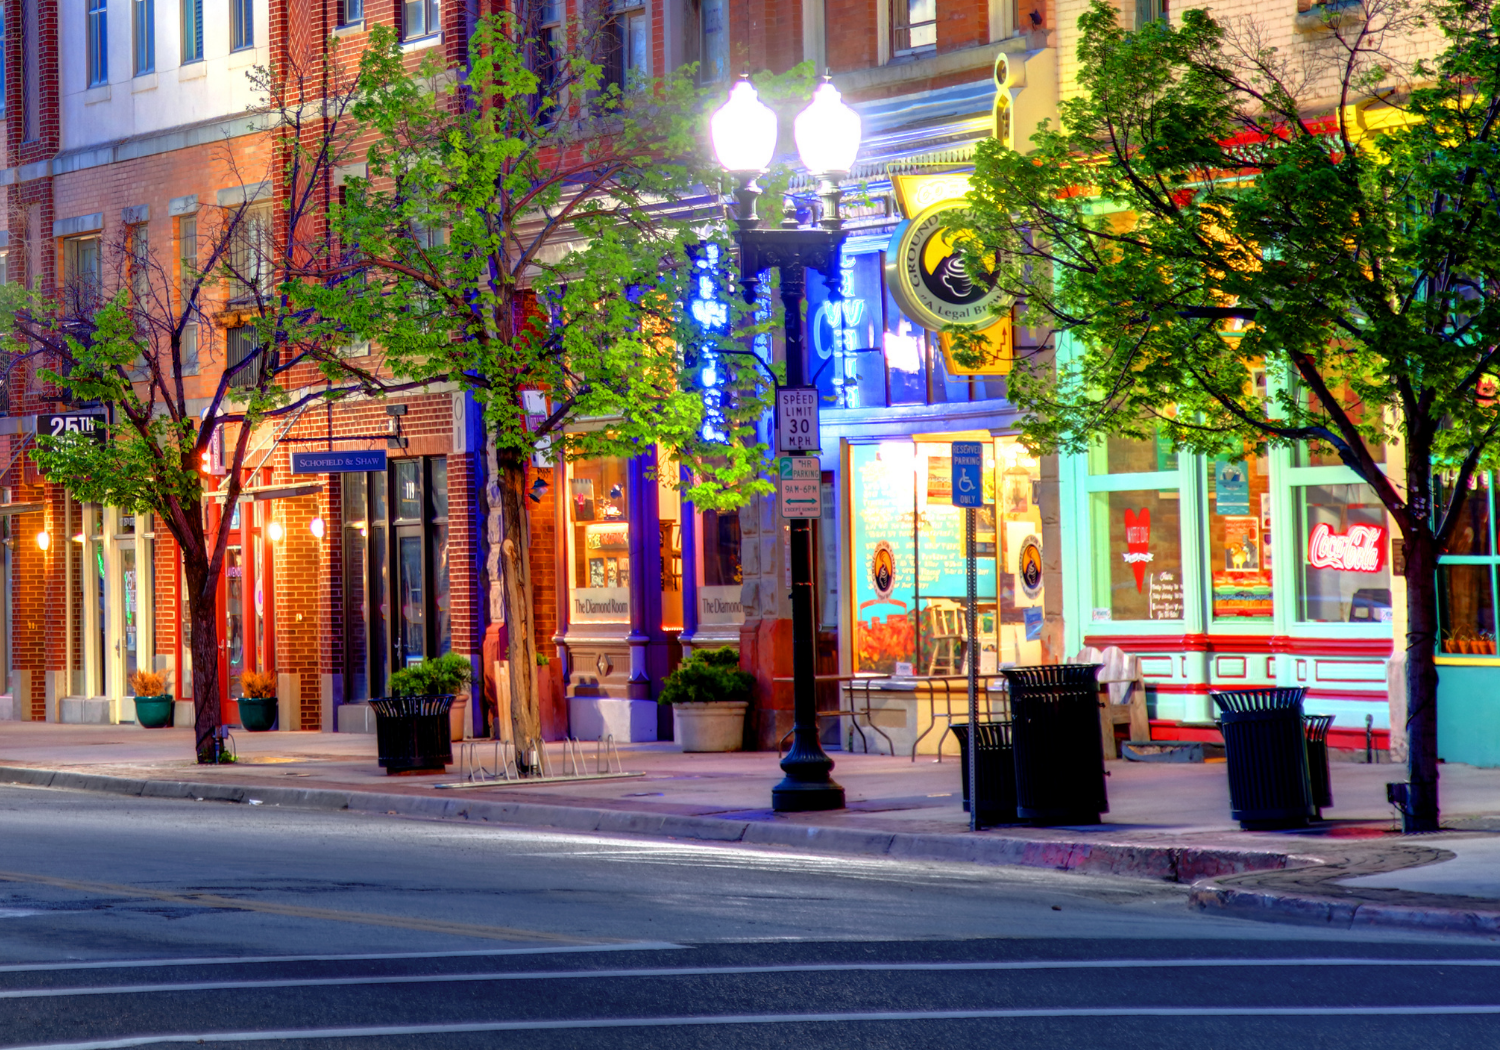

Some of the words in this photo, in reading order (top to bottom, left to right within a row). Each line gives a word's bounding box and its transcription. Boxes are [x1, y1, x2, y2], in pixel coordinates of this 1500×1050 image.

[907, 213, 940, 288] GROUND
[937, 305, 970, 321] Legal
[783, 394, 814, 405] SPEED
[786, 406, 812, 417] LIMIT
[790, 419, 809, 434] 30
[952, 444, 982, 455] RESERVED
[299, 457, 344, 468] SCHOFIELD
[345, 457, 354, 466] &
[355, 457, 380, 466] SHAW
[953, 456, 981, 465] PARKING
[780, 460, 792, 479] 2
[801, 460, 812, 468] HR
[793, 470, 819, 478] PARKING
[959, 495, 976, 504] ONLY
[574, 599, 585, 614] The
[585, 599, 611, 614] Diamond
[611, 599, 628, 614] Room
[702, 598, 713, 614] The
[713, 598, 741, 614] Diamond
